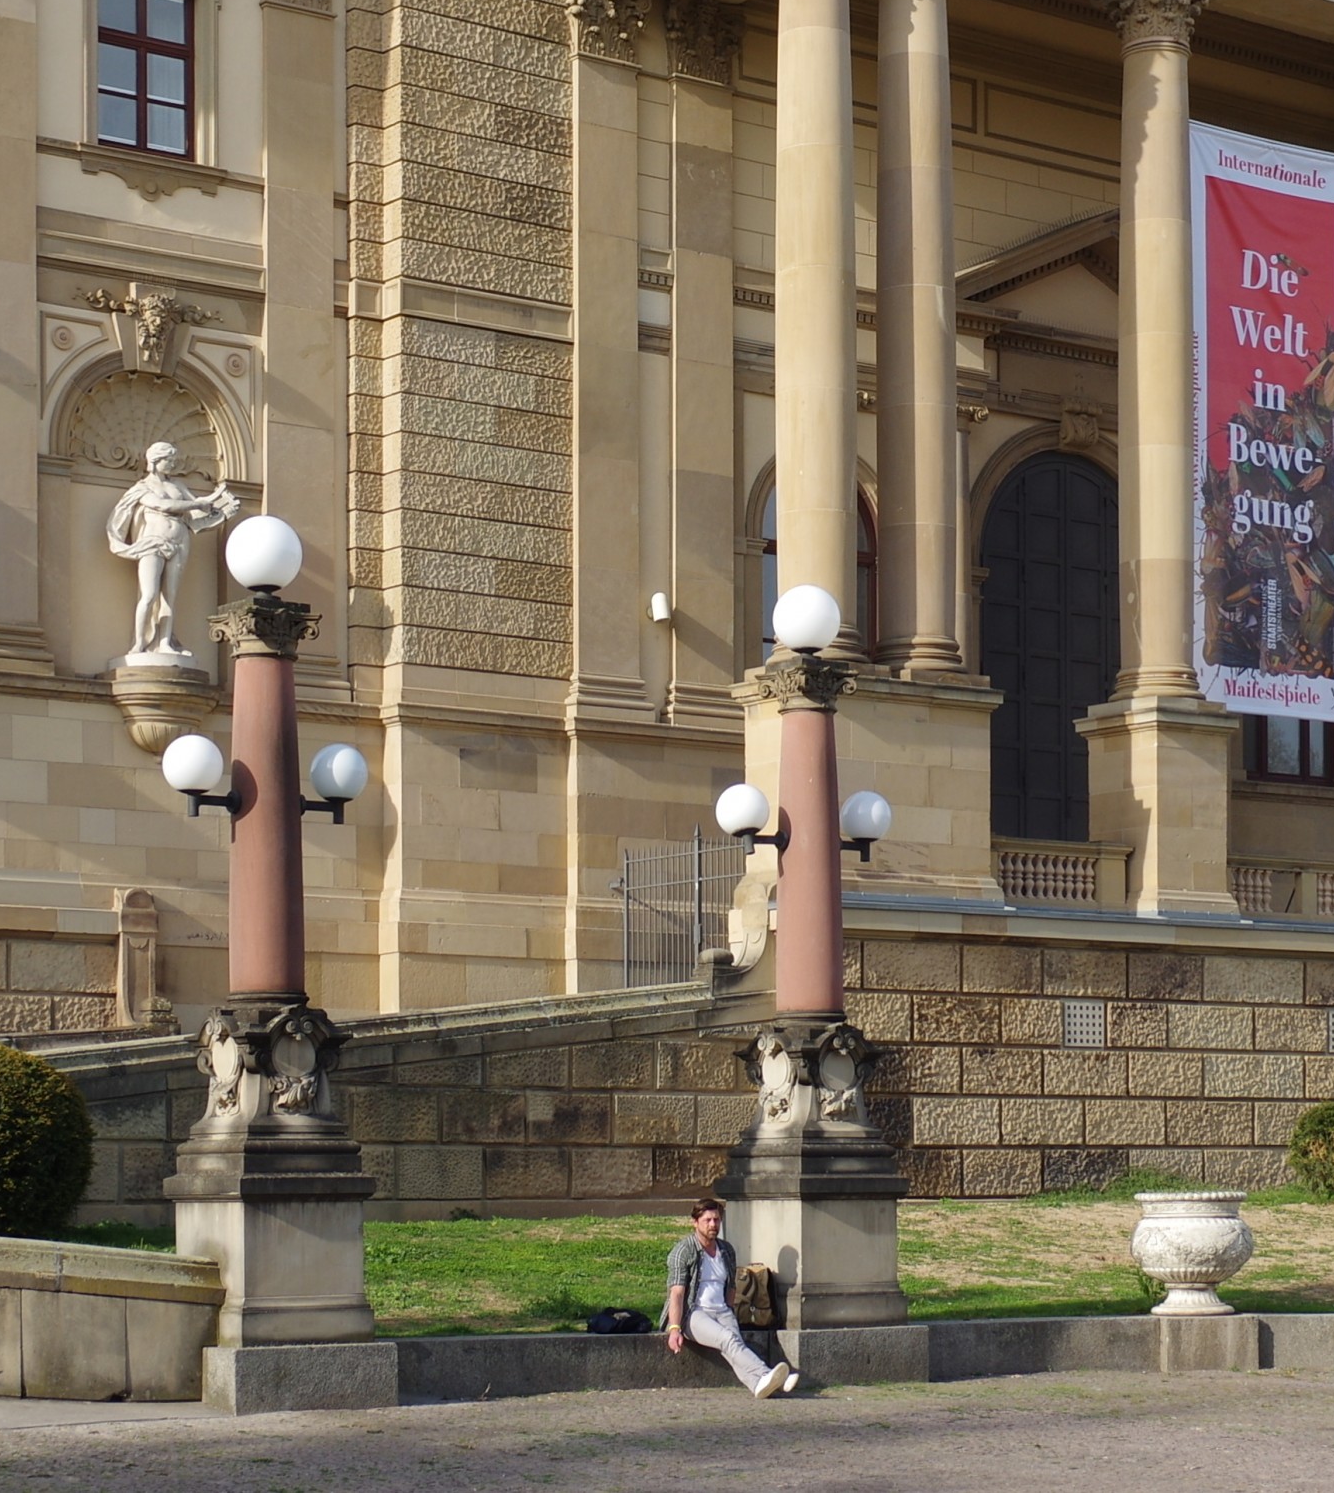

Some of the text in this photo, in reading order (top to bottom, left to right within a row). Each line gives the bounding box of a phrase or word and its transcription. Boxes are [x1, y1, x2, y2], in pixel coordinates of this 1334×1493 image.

[1218, 149, 1327, 189] Internationale
[1240, 249, 1299, 297] Die
[1229, 306, 1309, 358] Welt
[1253, 368, 1287, 412] in
[1228, 422, 1324, 474] Bewe-
[1232, 489, 1315, 544] gung
[1267, 578, 1277, 650] STAATSTHEATER
[1224, 678, 1320, 707] Maifestspiele
